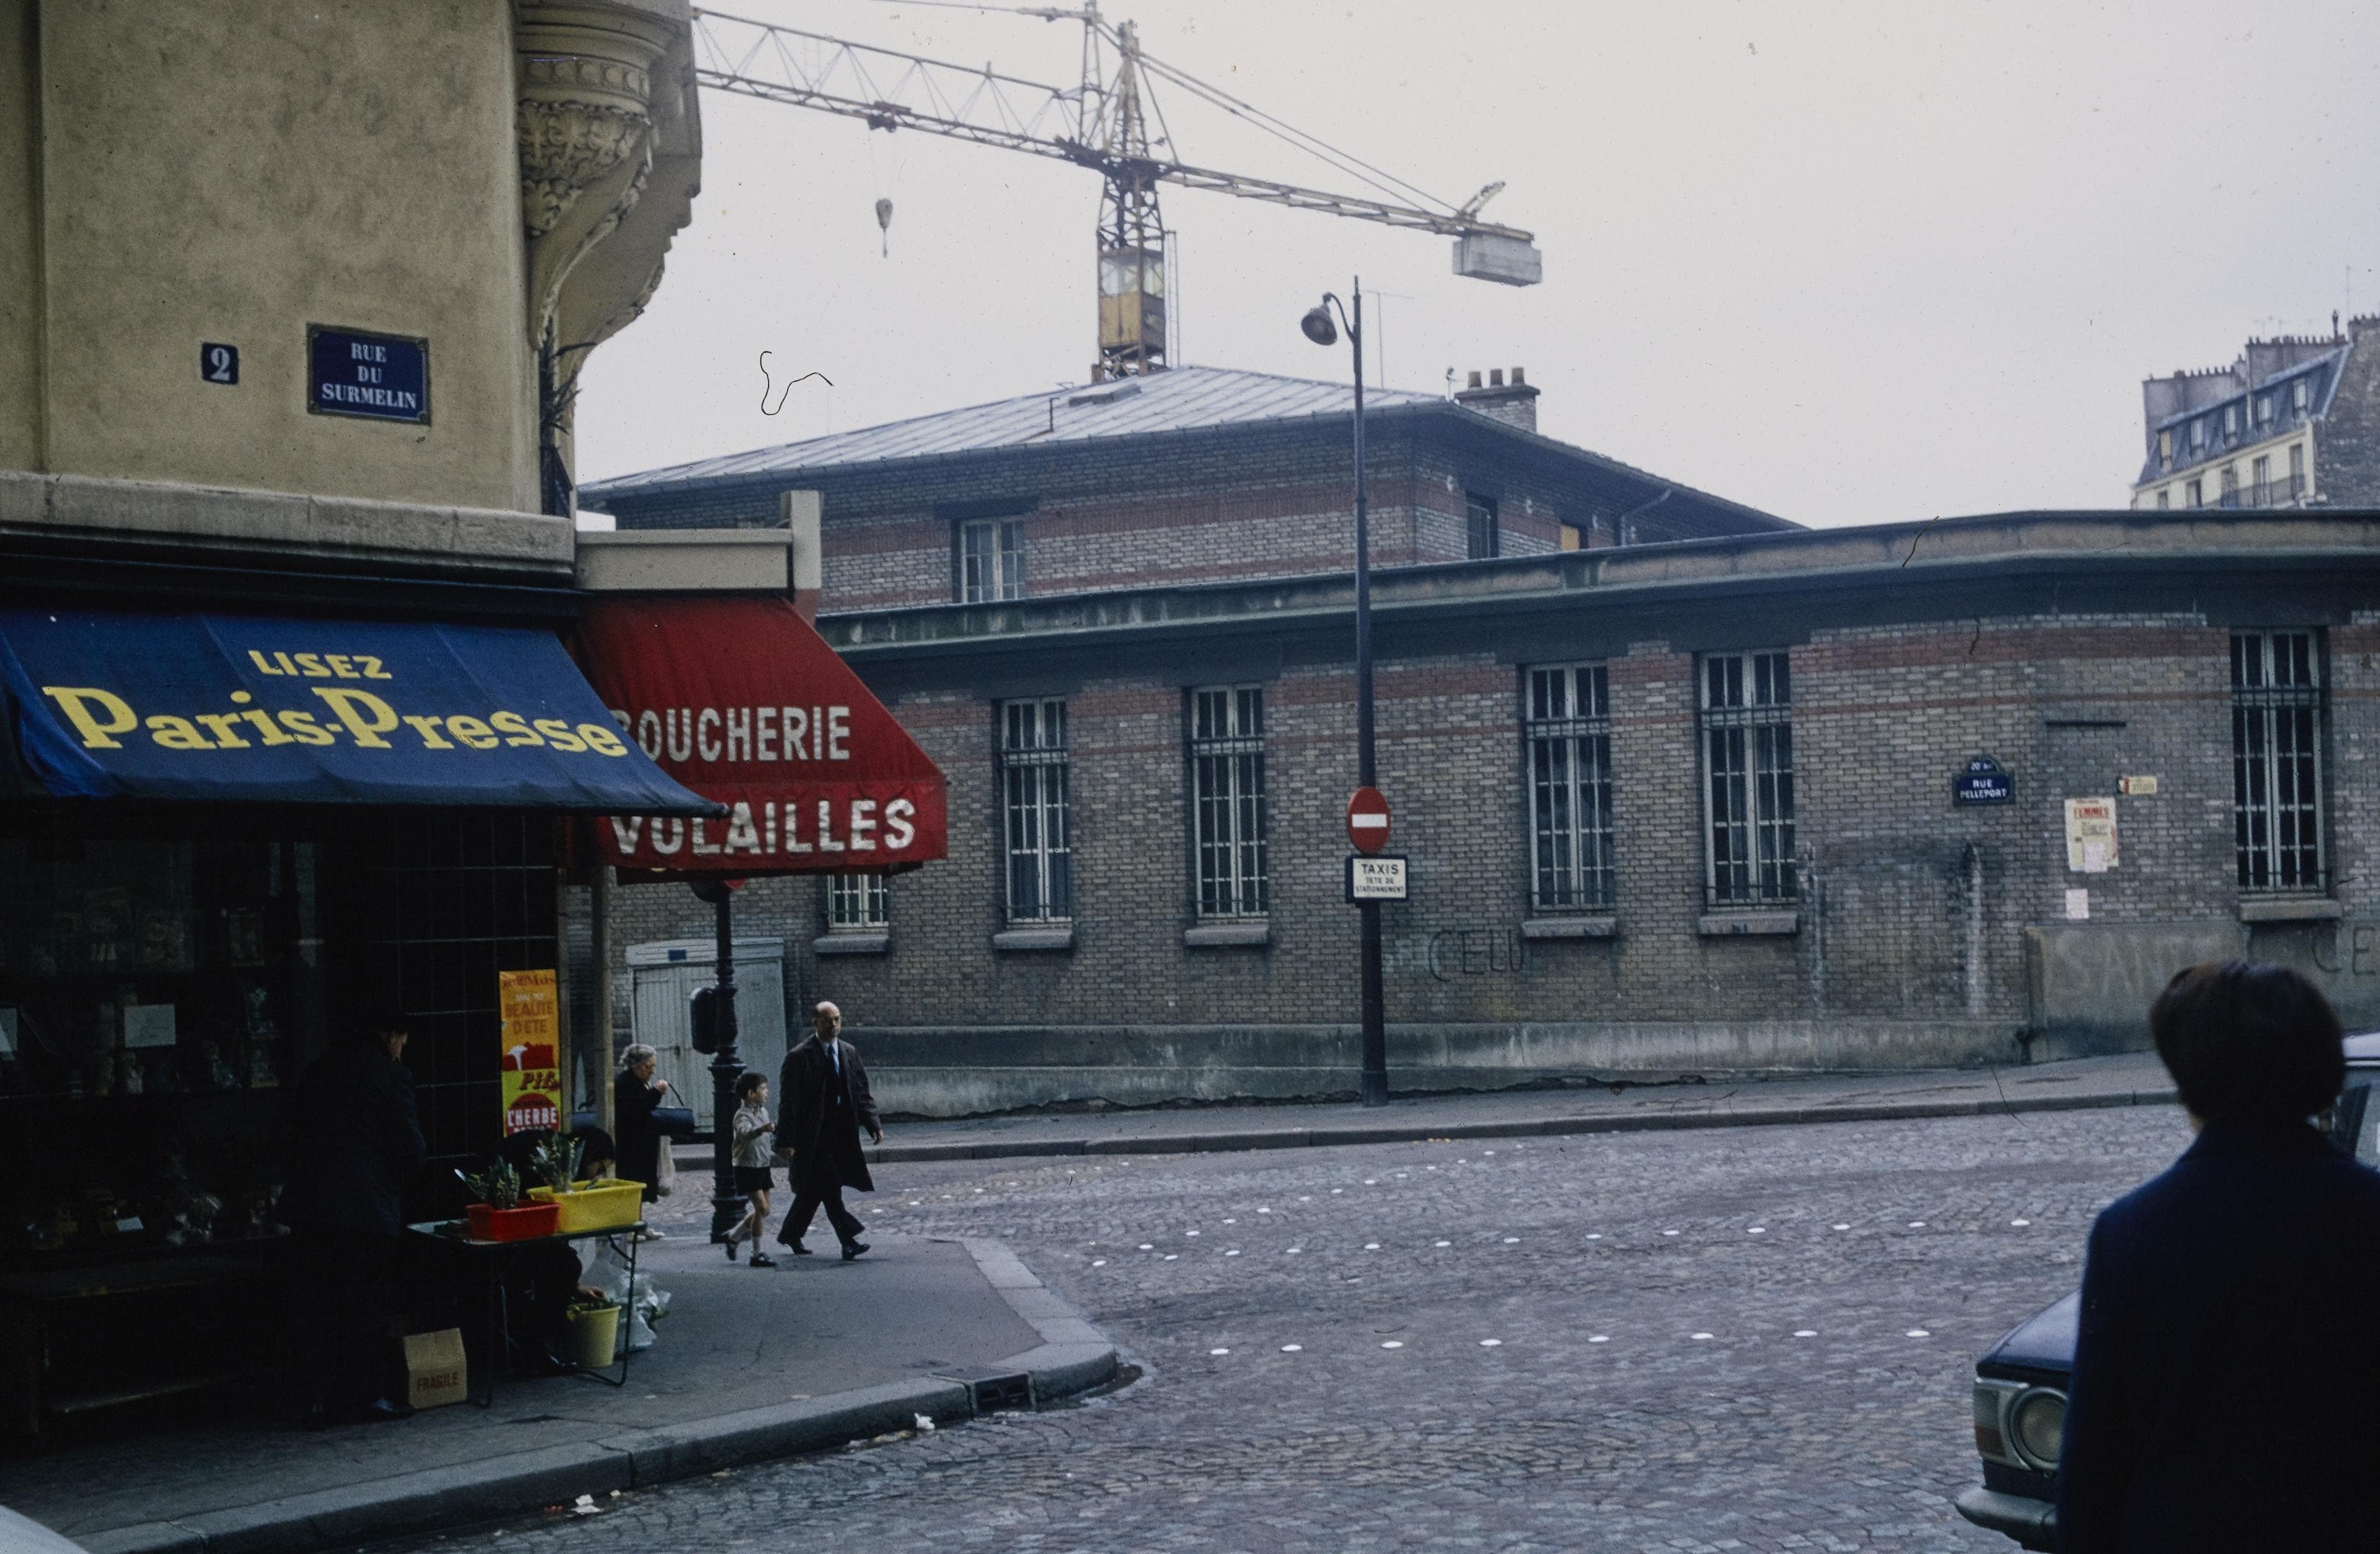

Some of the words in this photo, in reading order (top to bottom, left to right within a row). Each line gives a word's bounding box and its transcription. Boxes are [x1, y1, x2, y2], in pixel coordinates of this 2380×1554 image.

[351, 342, 386, 362] RUE
[210, 347, 232, 381] 2
[358, 365, 383, 383] DU
[322, 383, 417, 409] SURMELIN
[248, 649, 392, 679] LISEZ
[42, 686, 628, 757] Paris-Presse
[1972, 778, 1993, 789] RUE
[1959, 788, 2008, 800] PELLEPORT
[610, 798, 915, 854] VOLAILLES
[1361, 863, 1399, 875] TAXIS
[416, 1371, 459, 1391] FRAGILE
